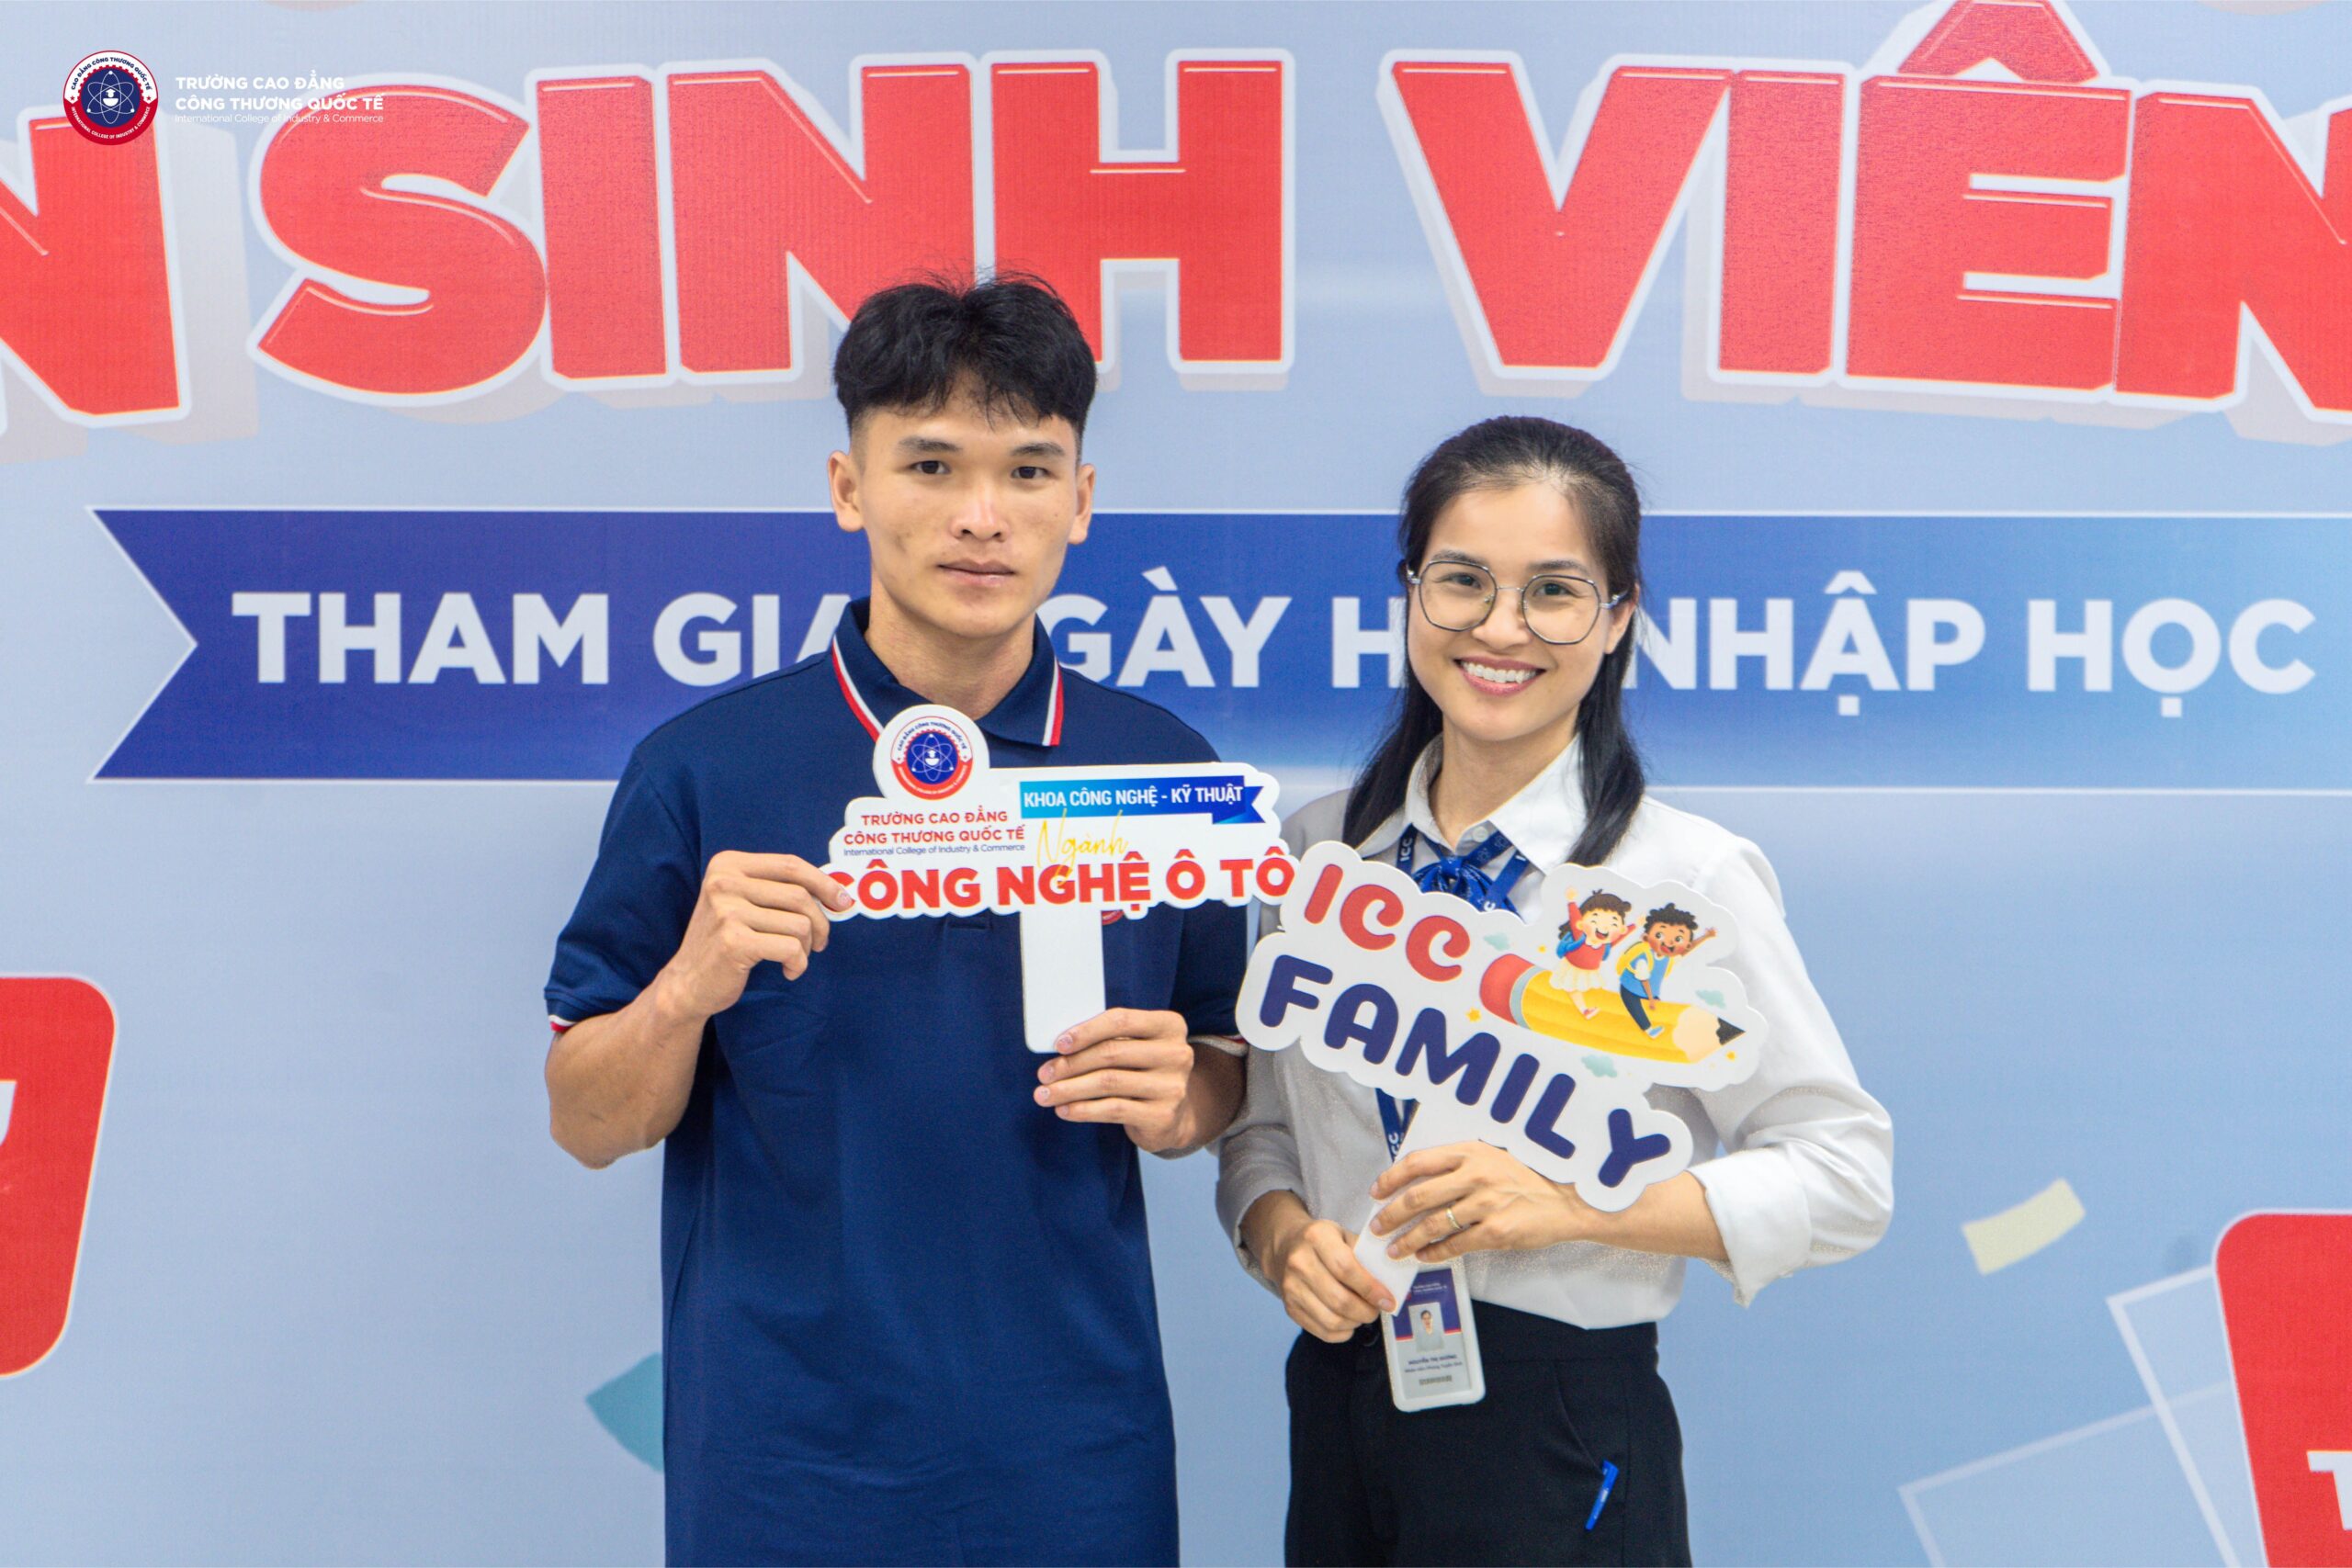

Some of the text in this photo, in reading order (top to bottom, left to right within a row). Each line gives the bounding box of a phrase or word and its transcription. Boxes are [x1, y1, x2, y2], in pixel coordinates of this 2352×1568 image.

[257, 61, 1283, 395] SINH
[1392, 0, 2352, 413] VIÊN
[232, 592, 610, 685] THAM
[1035, 565, 1292, 688] GÀY
[1623, 570, 1987, 716] NHẬP
[2027, 597, 2317, 718] HỌC
[861, 805, 1008, 827] TRƯỜNG CAO ĐẲNG
[1023, 791, 1067, 807] KHOA
[1069, 787, 1112, 807] CÔNG
[1115, 784, 1158, 807] NGHỆ
[1170, 784, 1193, 804] KỸ
[1195, 783, 1244, 806] THUẬT
[843, 824, 1025, 845] CÔNG THƯƠNG QUỐC TẾ
[843, 847, 895, 856] International
[896, 846, 926, 856] College
[928, 845, 937, 854] of
[938, 844, 971, 854] Industry
[980, 843, 1025, 852] Commerce
[1036, 807, 1129, 887] Ngành
[1400, 837, 1413, 863] ICC
[997, 852, 1150, 911] NGHỆ
[1166, 849, 1205, 900] Ô
[1219, 846, 1295, 897] TÔ
[1304, 863, 1471, 982] ICC
[1259, 953, 1671, 1189] FAMILY
